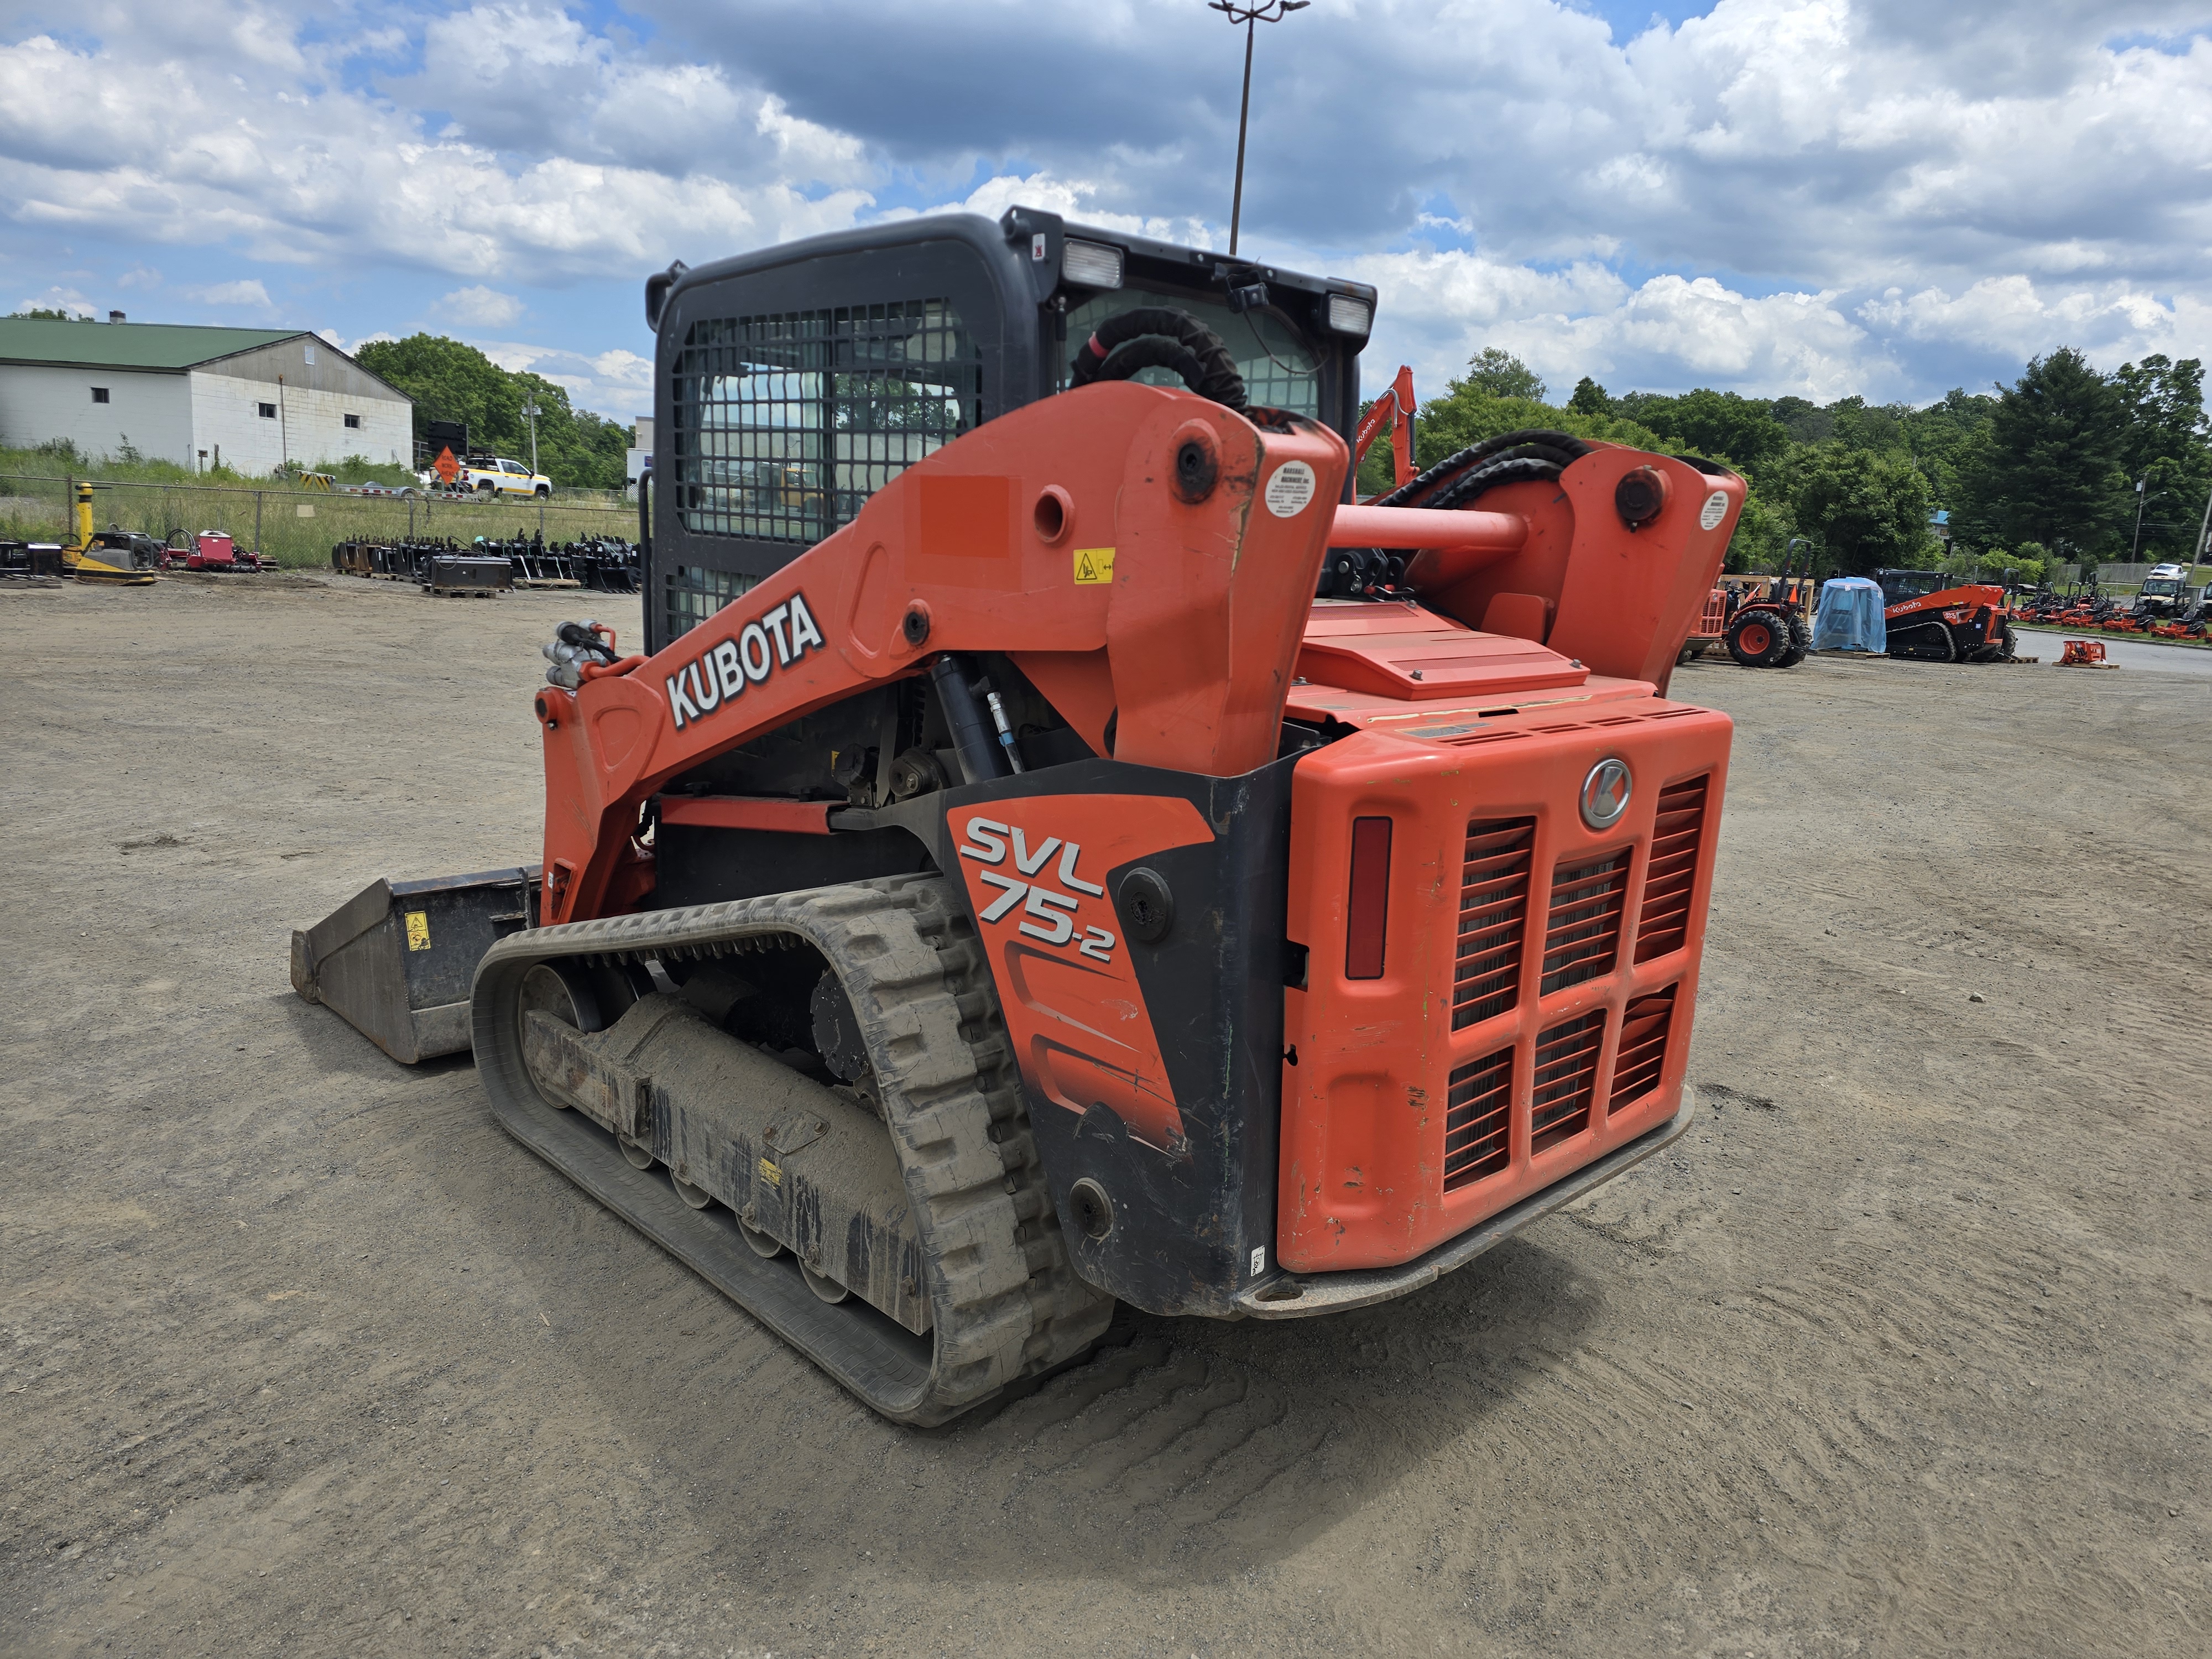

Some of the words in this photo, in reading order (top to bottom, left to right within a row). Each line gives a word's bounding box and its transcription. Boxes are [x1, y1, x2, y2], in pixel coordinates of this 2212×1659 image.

[1356, 419, 1375, 443] Kubota
[1892, 601, 1922, 613] Kubota
[666, 594, 823, 728] KUBOTA
[959, 817, 1104, 896] SVL
[979, 869, 1115, 962] 75-2
